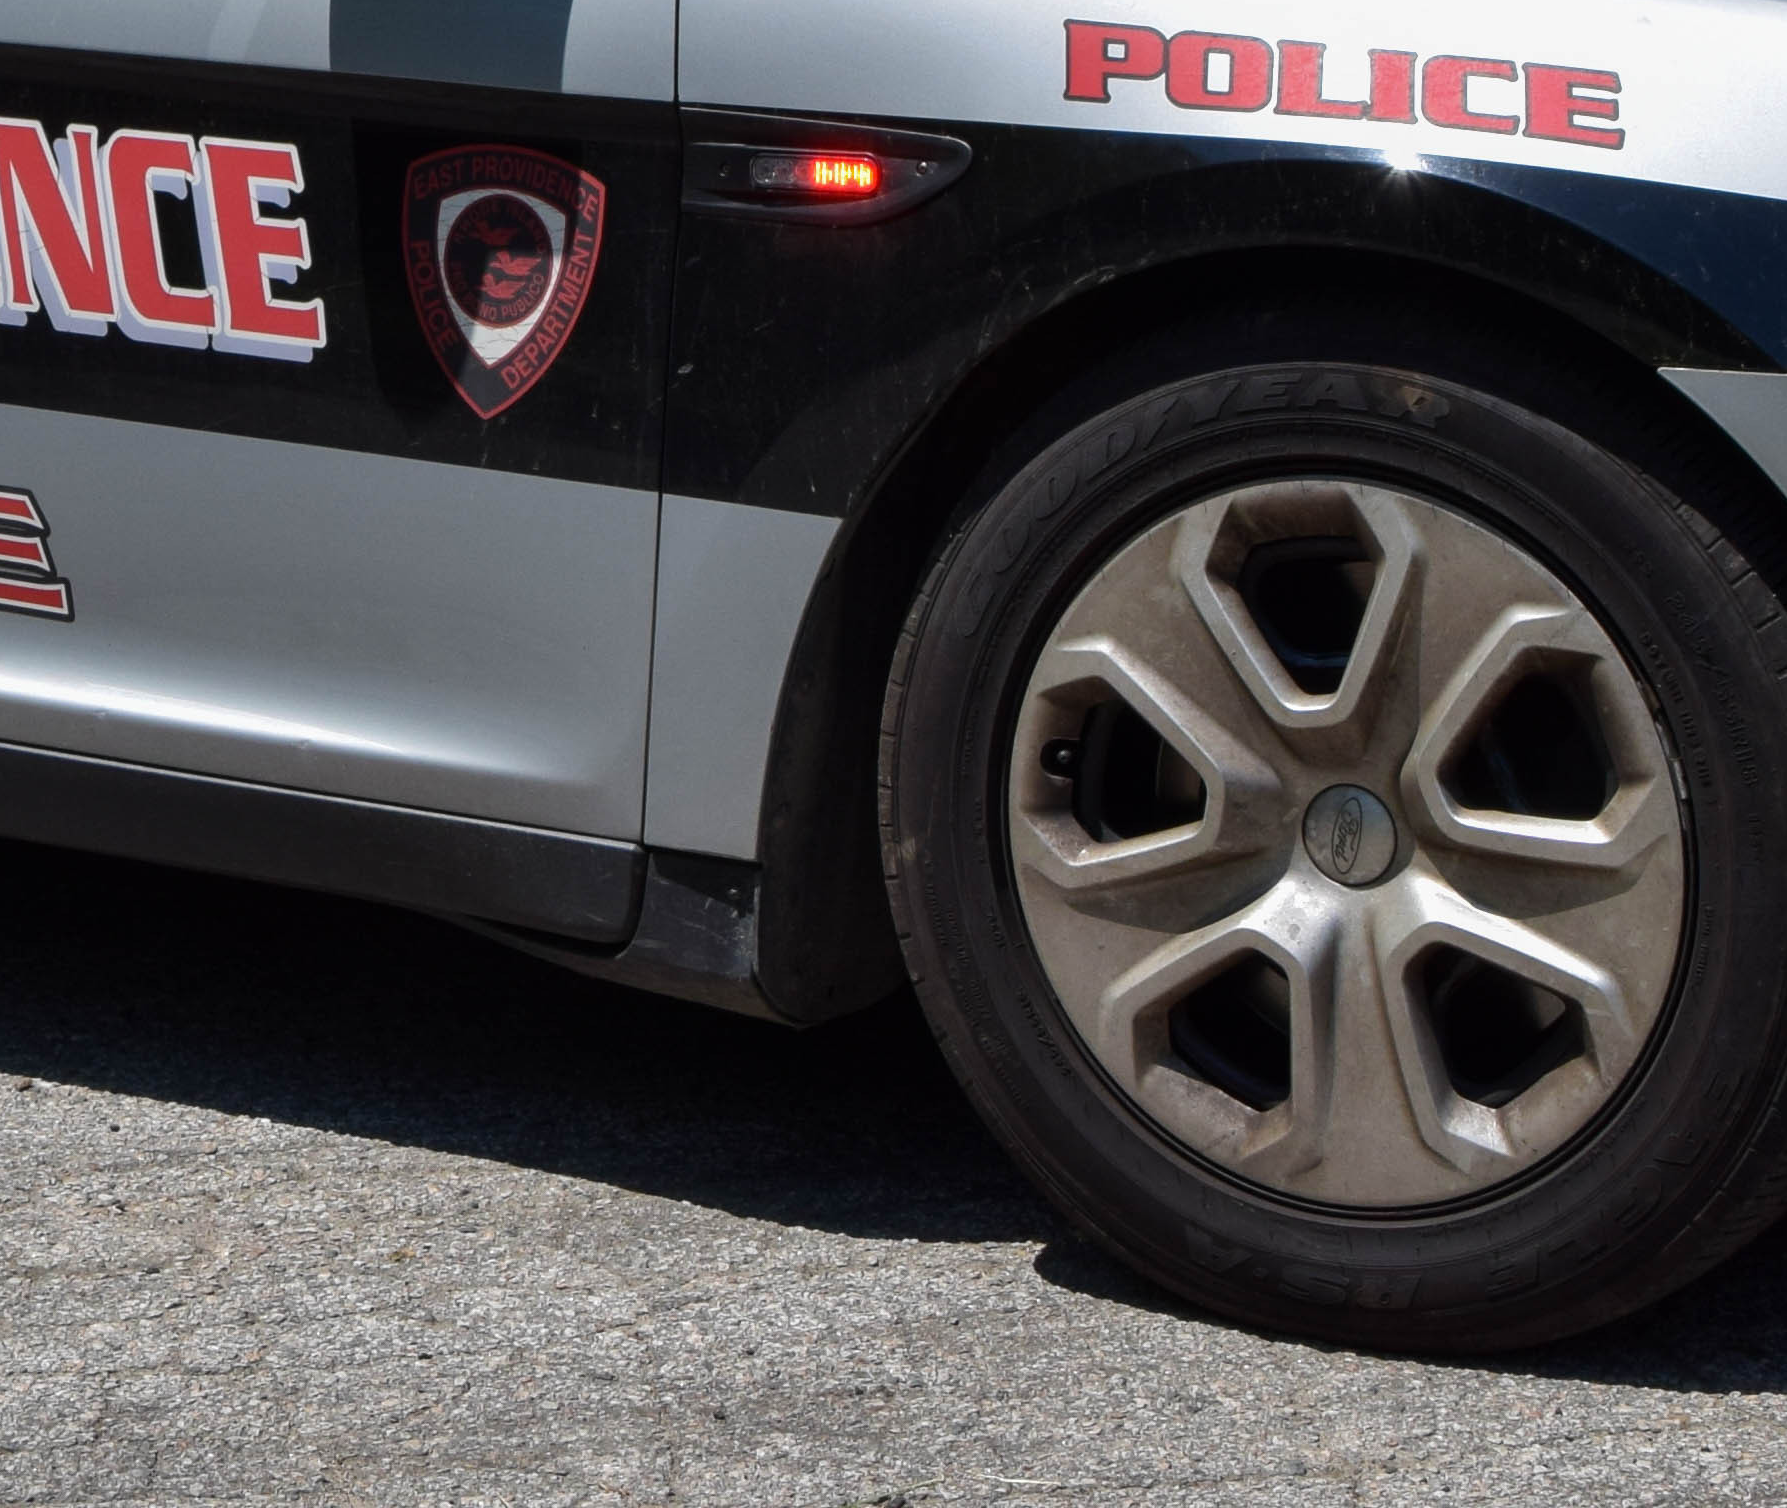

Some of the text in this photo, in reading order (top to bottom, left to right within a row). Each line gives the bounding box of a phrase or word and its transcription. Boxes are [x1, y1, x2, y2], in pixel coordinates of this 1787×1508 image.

[1063, 18, 1625, 150] POLICE
[414, 156, 599, 224] EAST PROVIDENCE
[412, 241, 458, 350] POLICE
[500, 228, 594, 389] DEPARTMENT
[961, 372, 1451, 638] GOODYEAR
